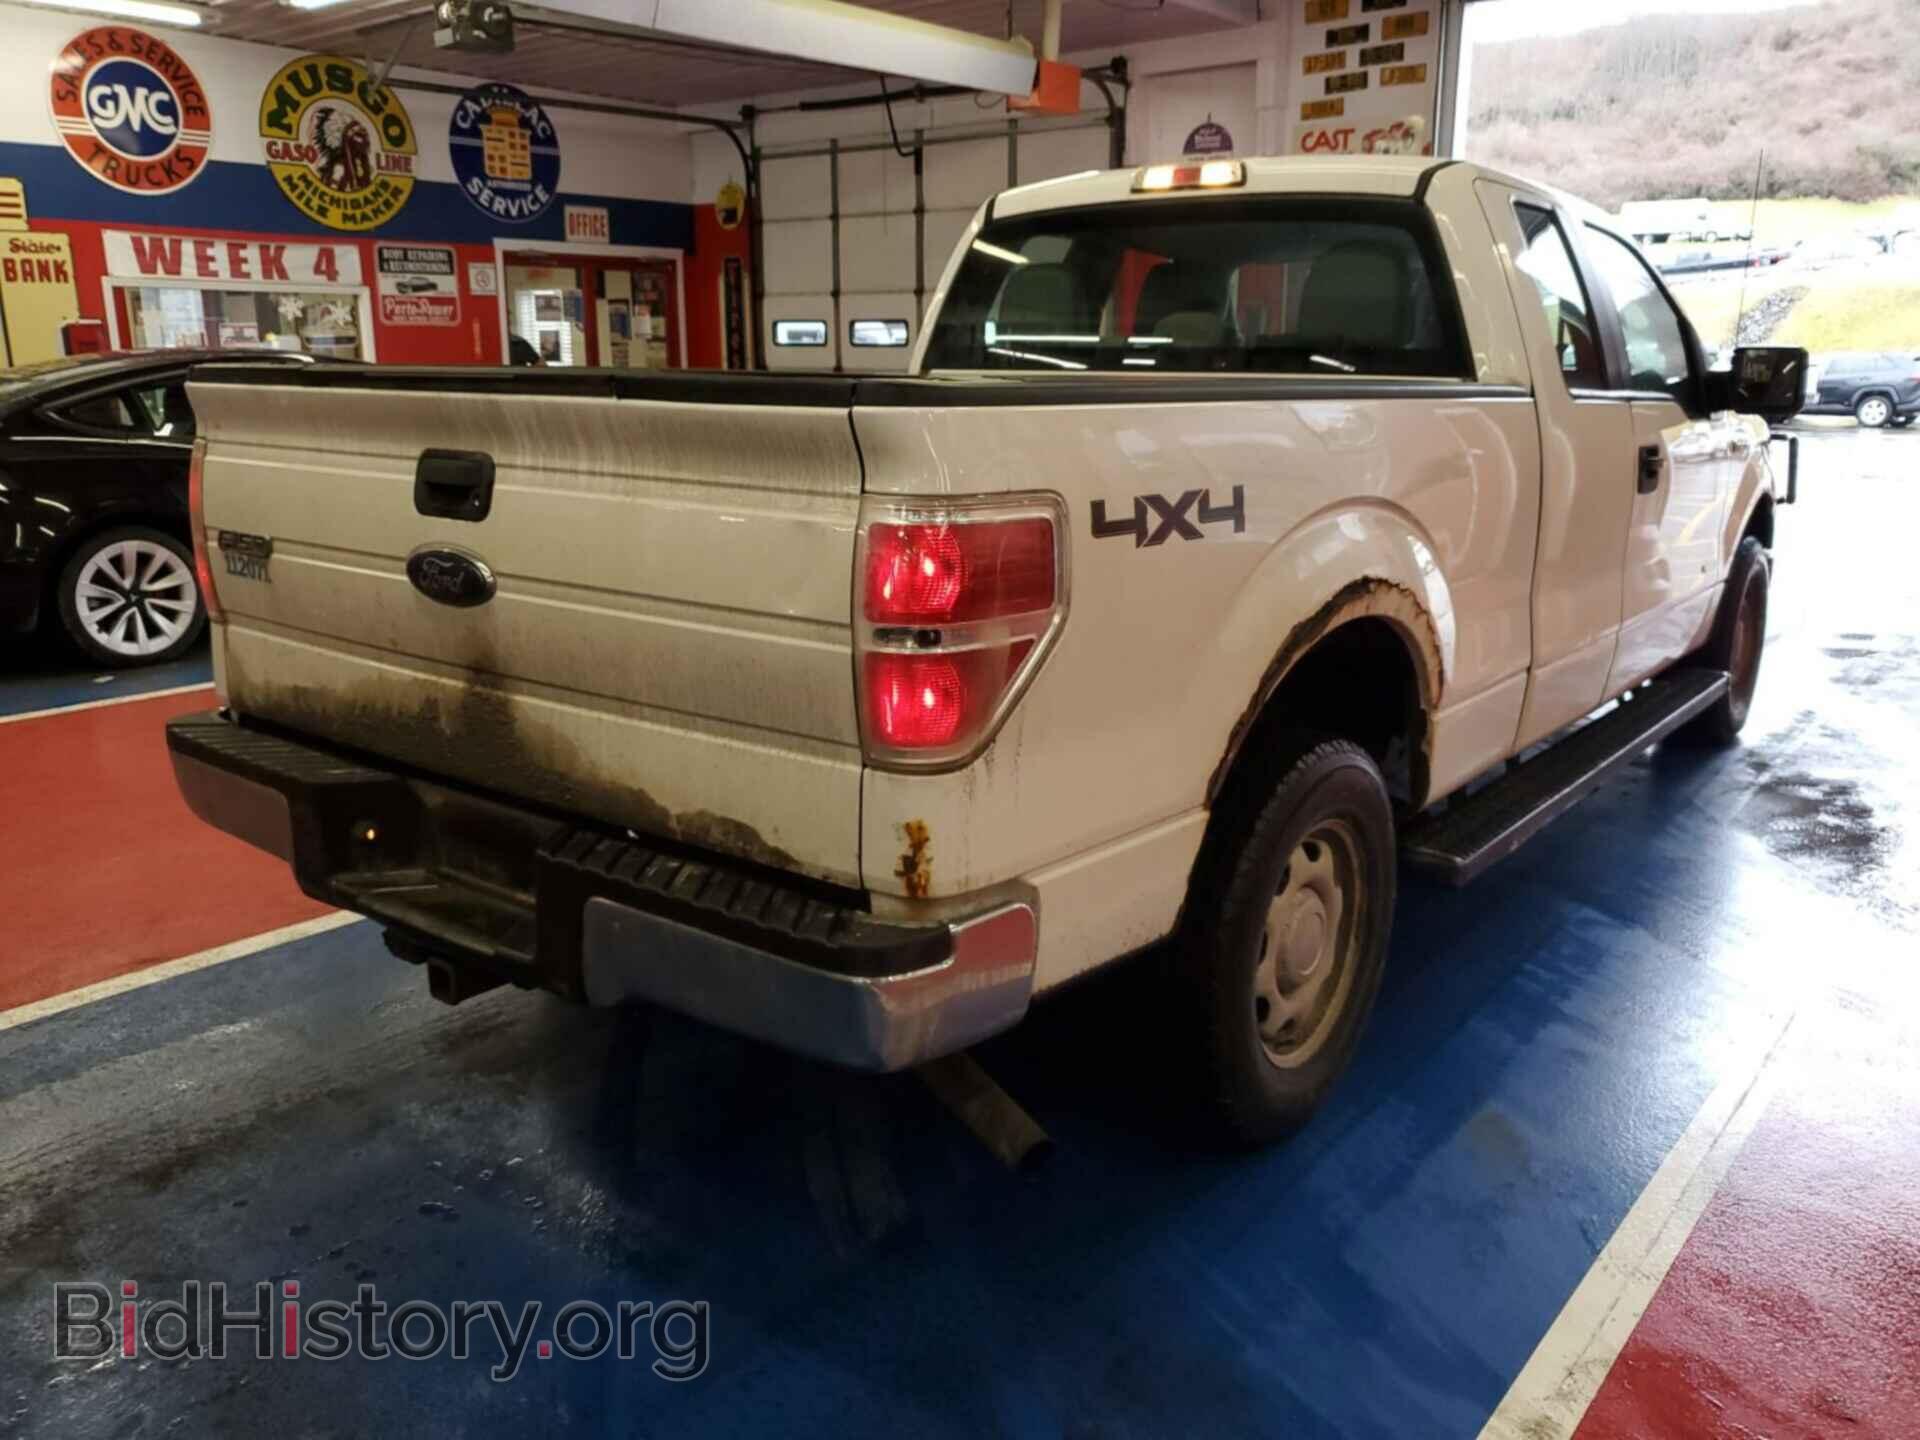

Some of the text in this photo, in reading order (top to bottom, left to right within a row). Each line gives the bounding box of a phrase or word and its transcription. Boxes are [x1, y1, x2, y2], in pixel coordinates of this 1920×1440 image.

[56, 31, 205, 116] SAES & SERVICE
[89, 84, 177, 134] GMC
[266, 140, 412, 173] GASO LINE
[1301, 128, 1356, 153] CAST
[86, 142, 194, 186] TRUCKS
[282, 174, 403, 225] MILE MAKER
[297, 173, 391, 209] MICHIGANS
[467, 177, 549, 217] SERVICE
[569, 212, 608, 238] OFFICE
[9, 237, 61, 254] State
[130, 235, 339, 282] WEEK 4
[2, 257, 69, 284] BANK
[1090, 485, 1246, 549] 4X4
[417, 557, 465, 593] Ford
